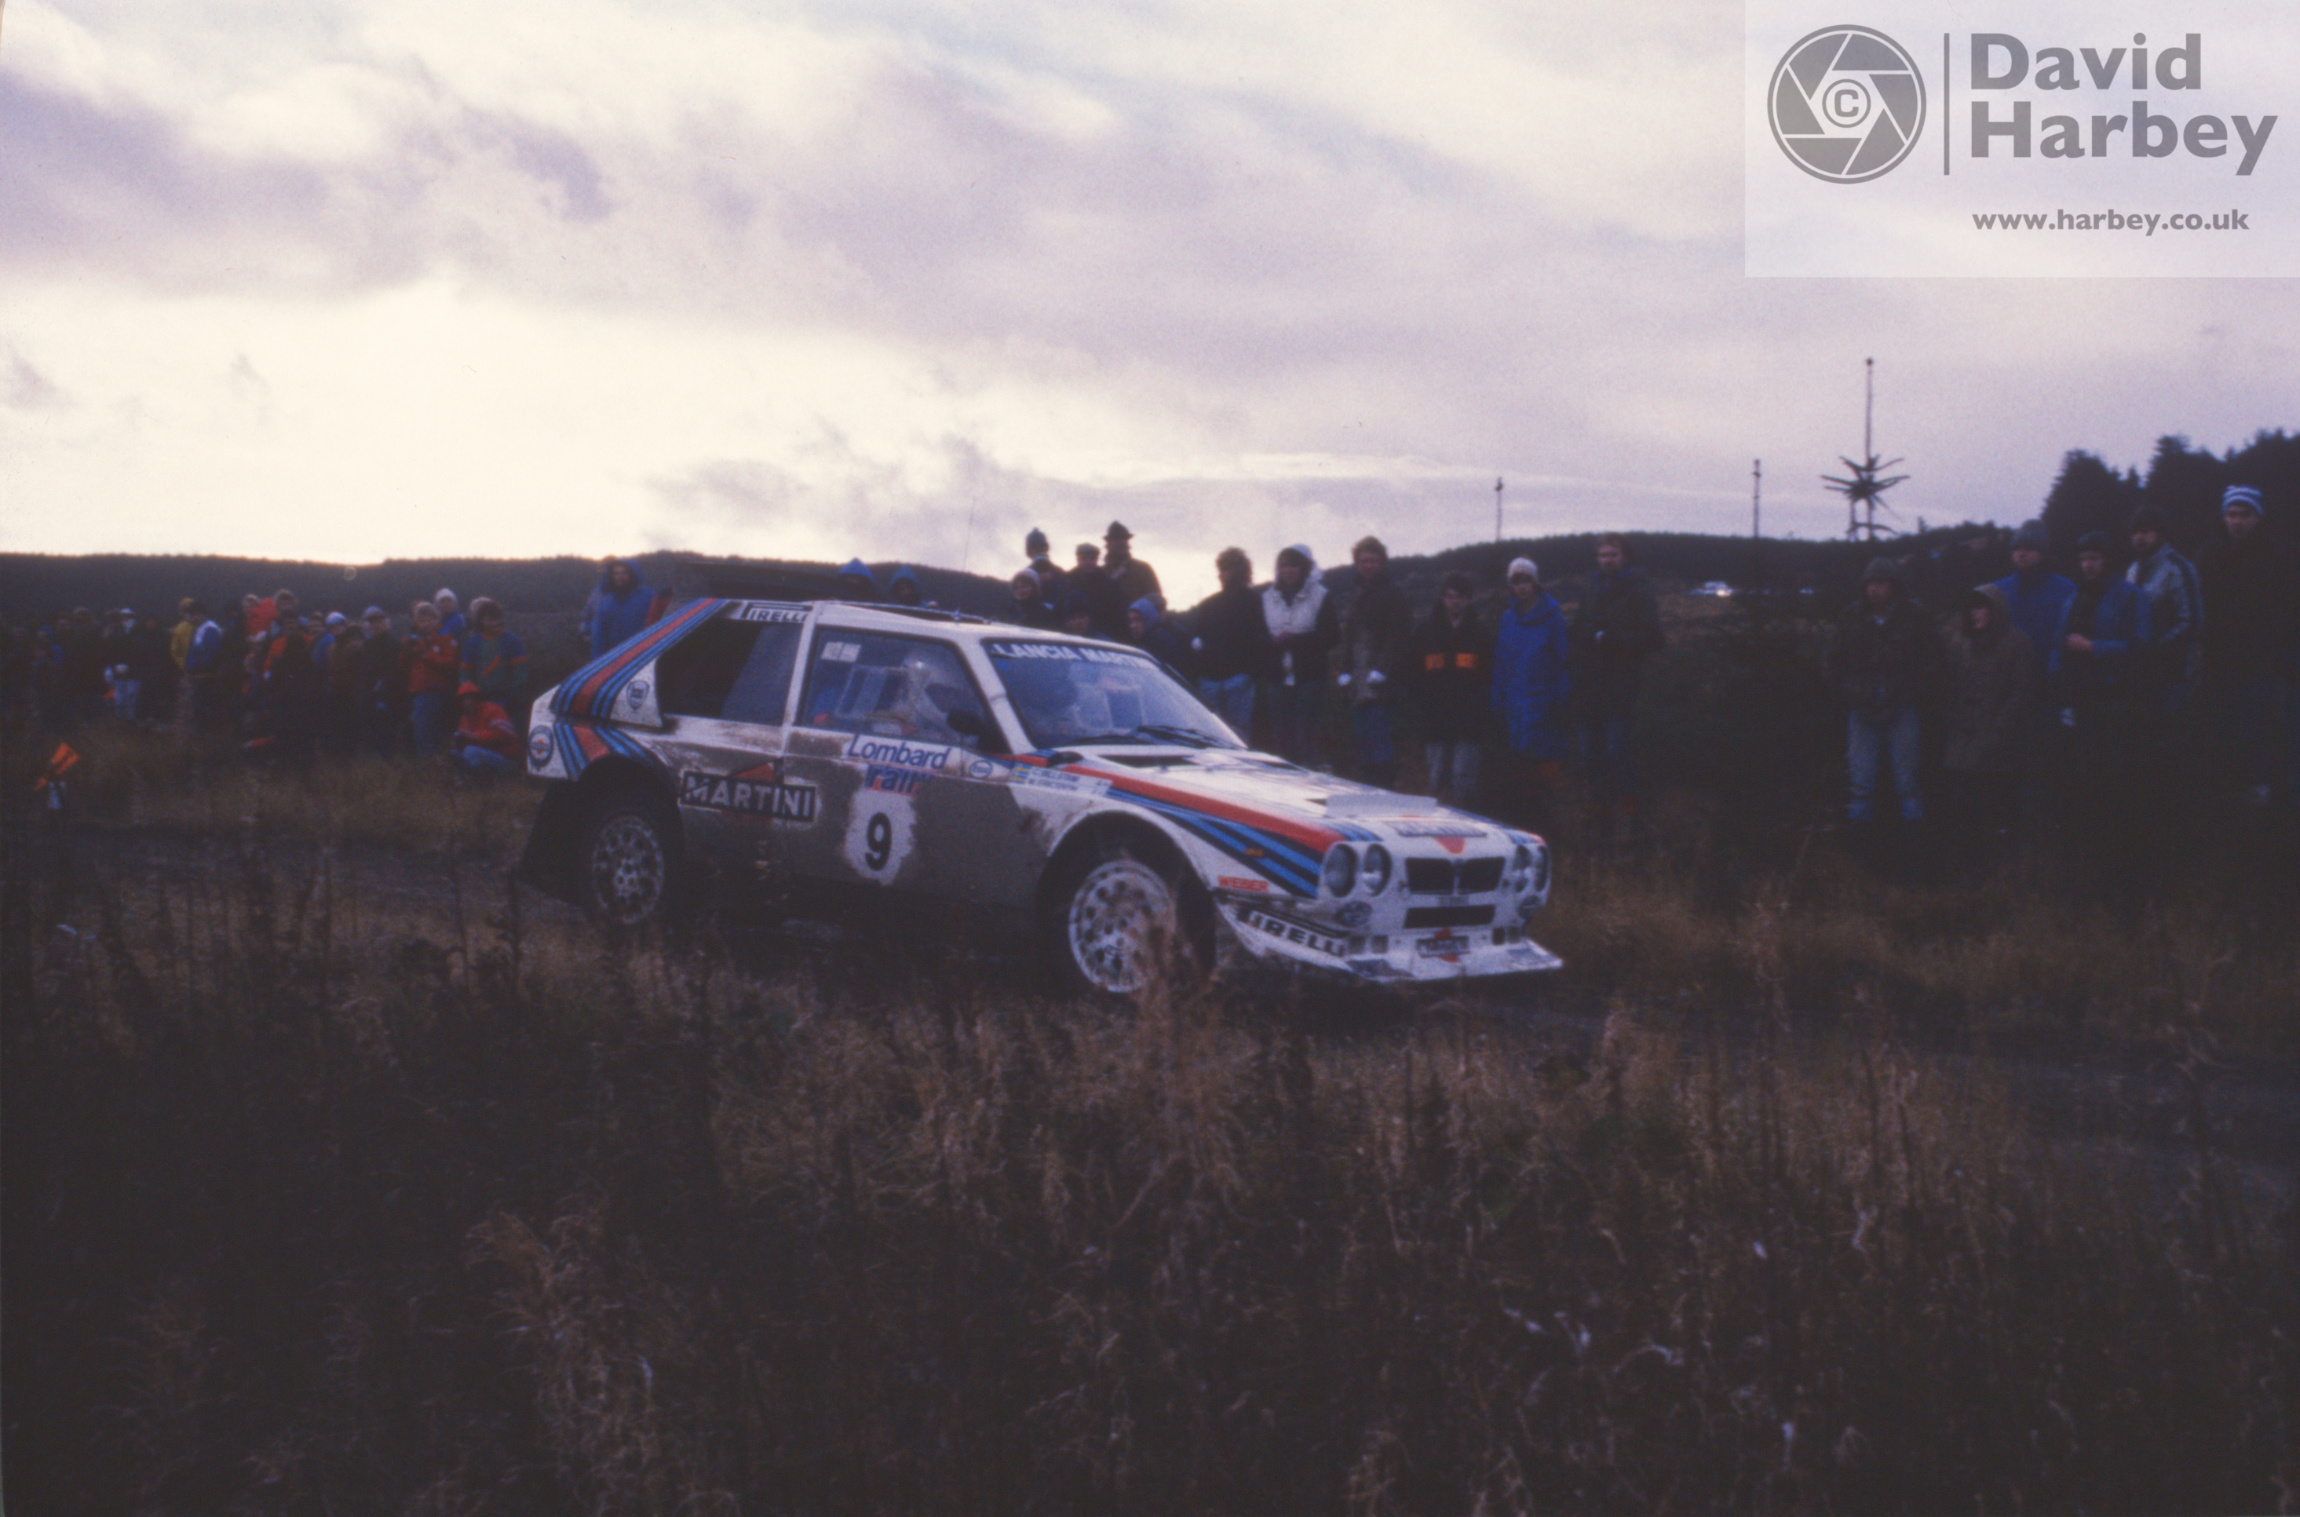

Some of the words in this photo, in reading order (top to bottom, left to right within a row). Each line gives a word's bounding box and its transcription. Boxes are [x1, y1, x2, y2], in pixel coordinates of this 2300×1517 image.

[993, 643, 1082, 660] LANCIA
[847, 733, 952, 770] Lombard
[684, 774, 812, 818] MARTINI
[865, 812, 892, 871] 9
